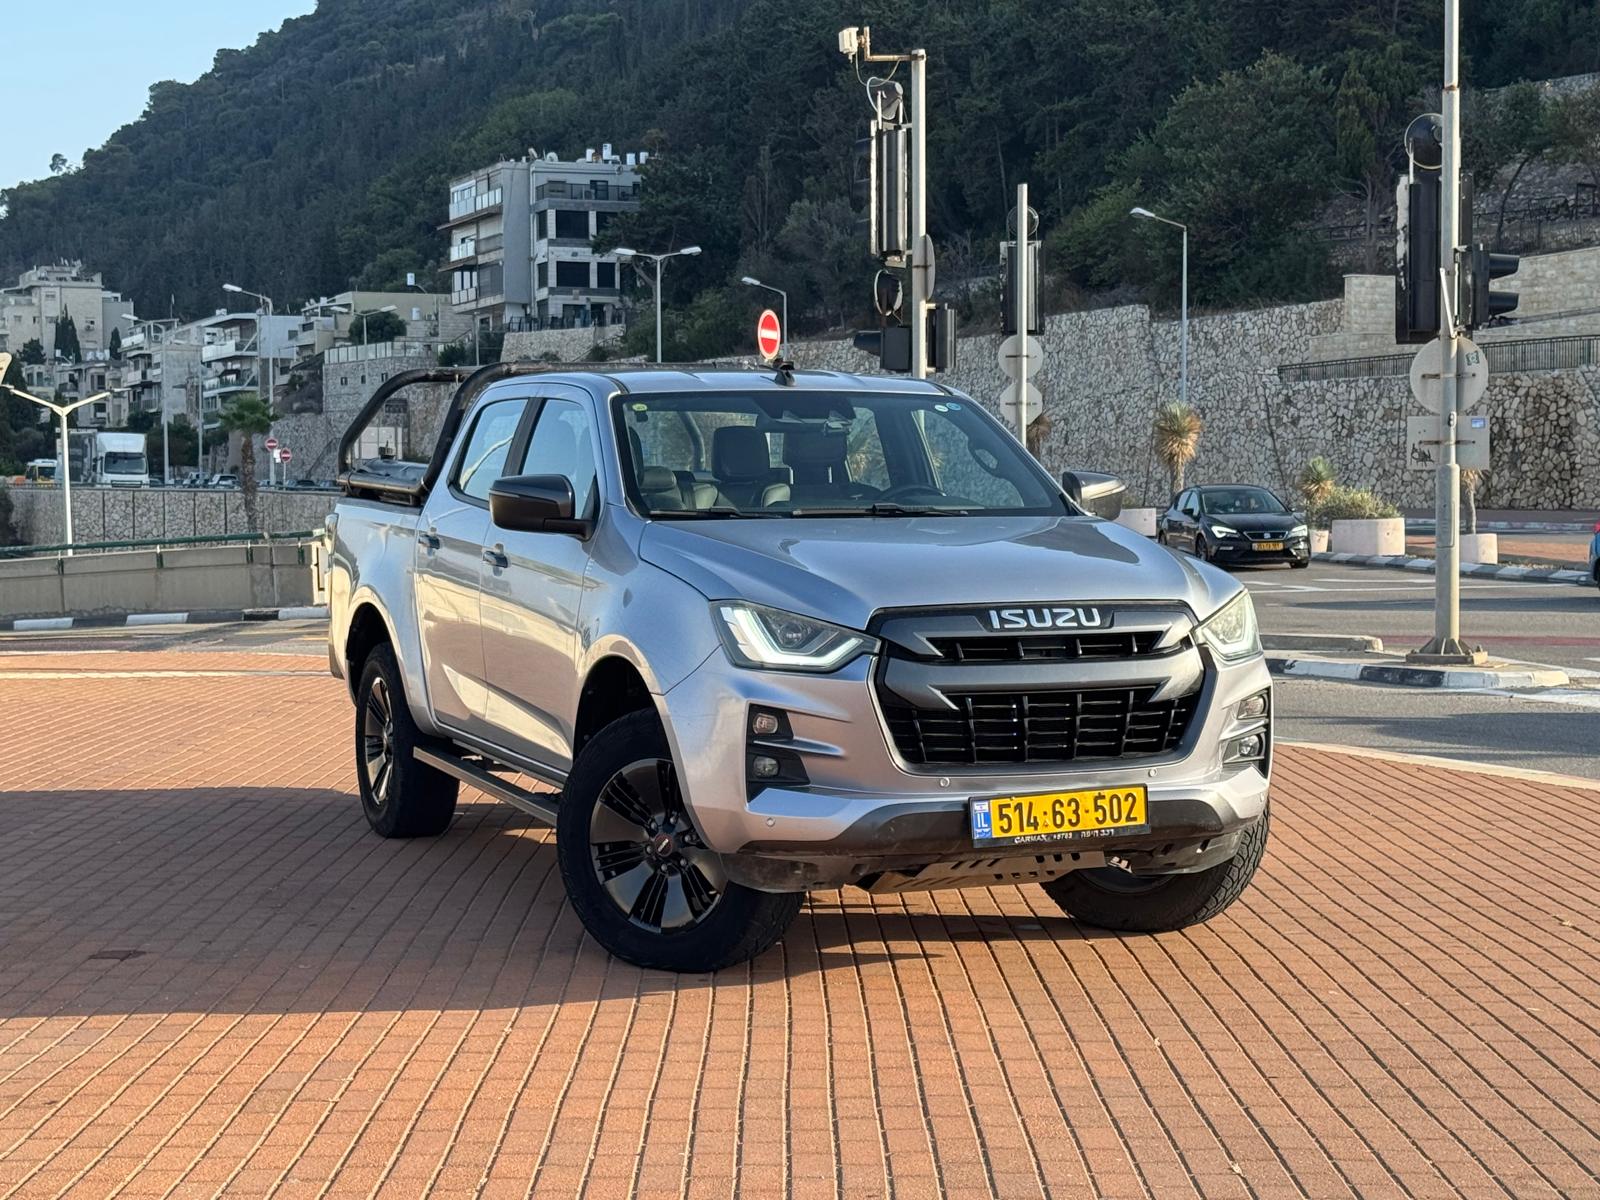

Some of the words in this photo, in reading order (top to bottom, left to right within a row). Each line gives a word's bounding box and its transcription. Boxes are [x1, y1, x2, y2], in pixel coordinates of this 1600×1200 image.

[989, 607, 1101, 629] ISUZU
[977, 812, 988, 828] IL
[1014, 834, 1048, 844] CARMAX
